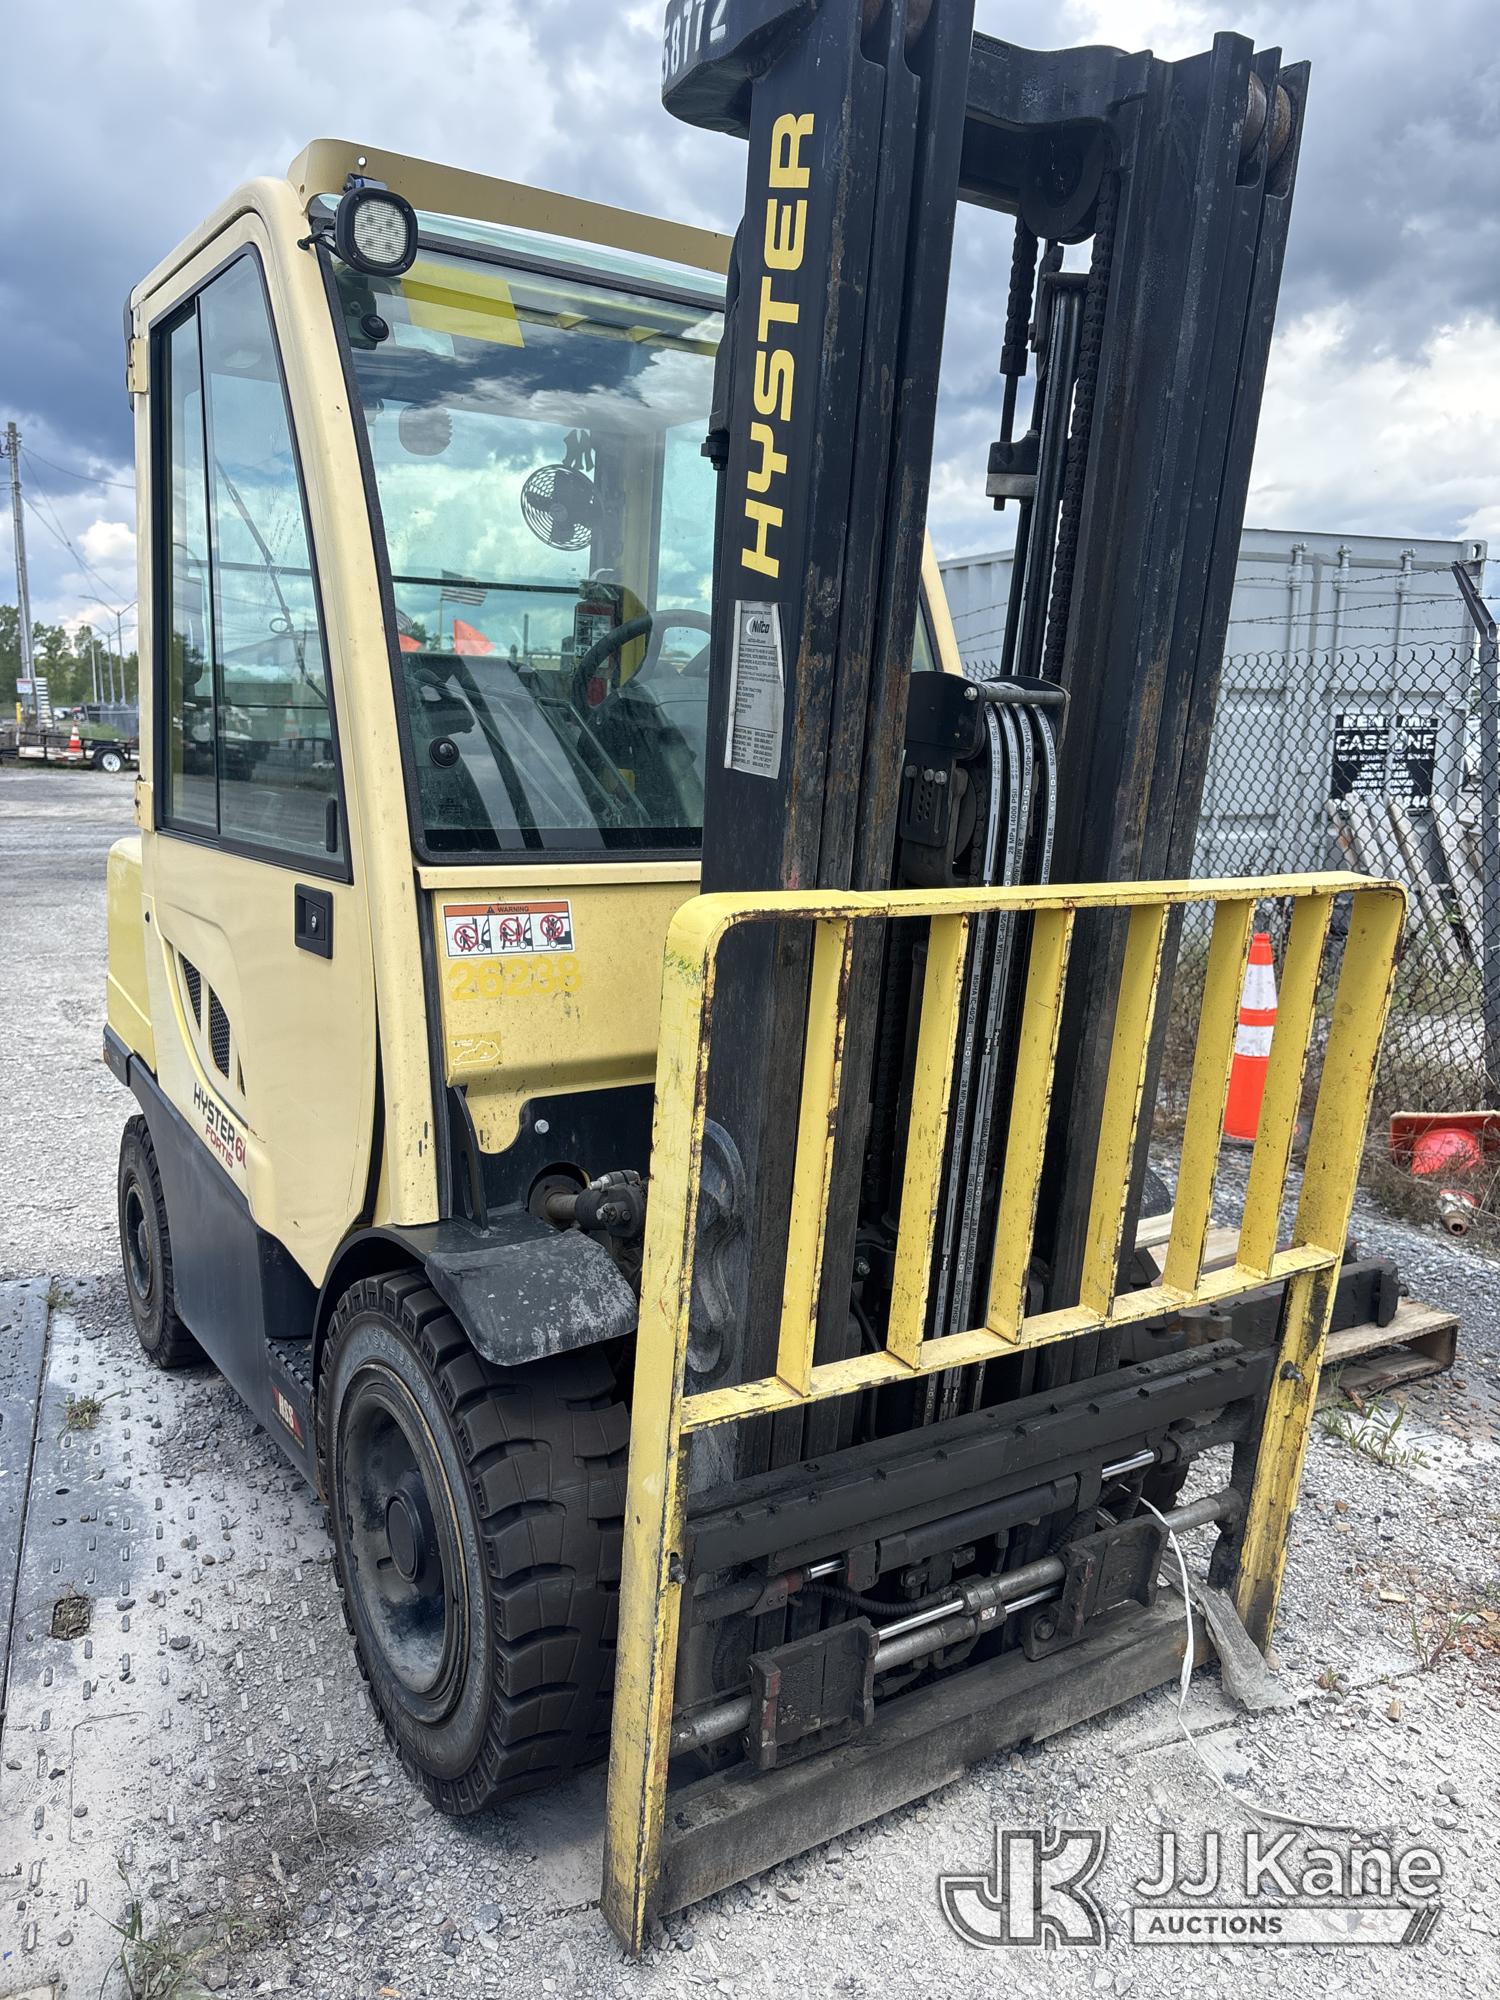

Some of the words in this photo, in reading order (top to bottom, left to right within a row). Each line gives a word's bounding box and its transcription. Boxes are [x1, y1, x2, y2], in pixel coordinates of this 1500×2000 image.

[741, 113, 815, 579] HYSTER
[1021, 718, 1032, 743] MSHA
[1335, 734, 1434, 751] CASSNE
[1010, 806, 1018, 826] (4000
[497, 905, 529, 914] WARNING
[449, 954, 583, 1001] 26238
[971, 974, 980, 996] MSHA
[968, 997, 978, 1025] IC-40/26
[193, 1082, 236, 1151] HYSTER
[205, 1124, 234, 1169] FORTIS
